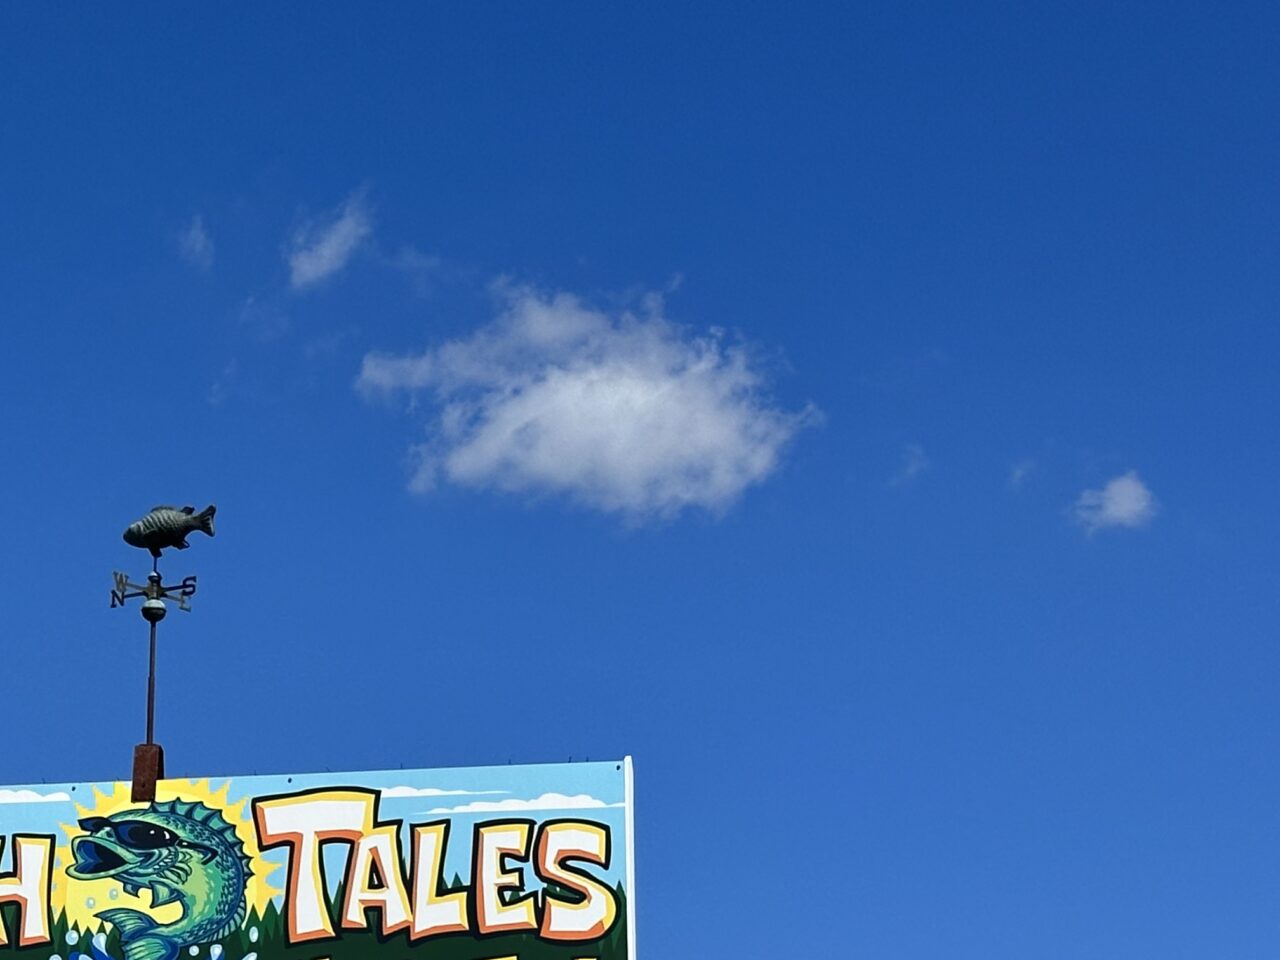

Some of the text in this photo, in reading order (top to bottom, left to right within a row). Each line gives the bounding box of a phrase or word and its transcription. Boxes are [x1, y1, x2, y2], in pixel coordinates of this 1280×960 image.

[182, 576, 197, 596] S
[110, 589, 125, 608] N
[252, 786, 618, 945] TALES
